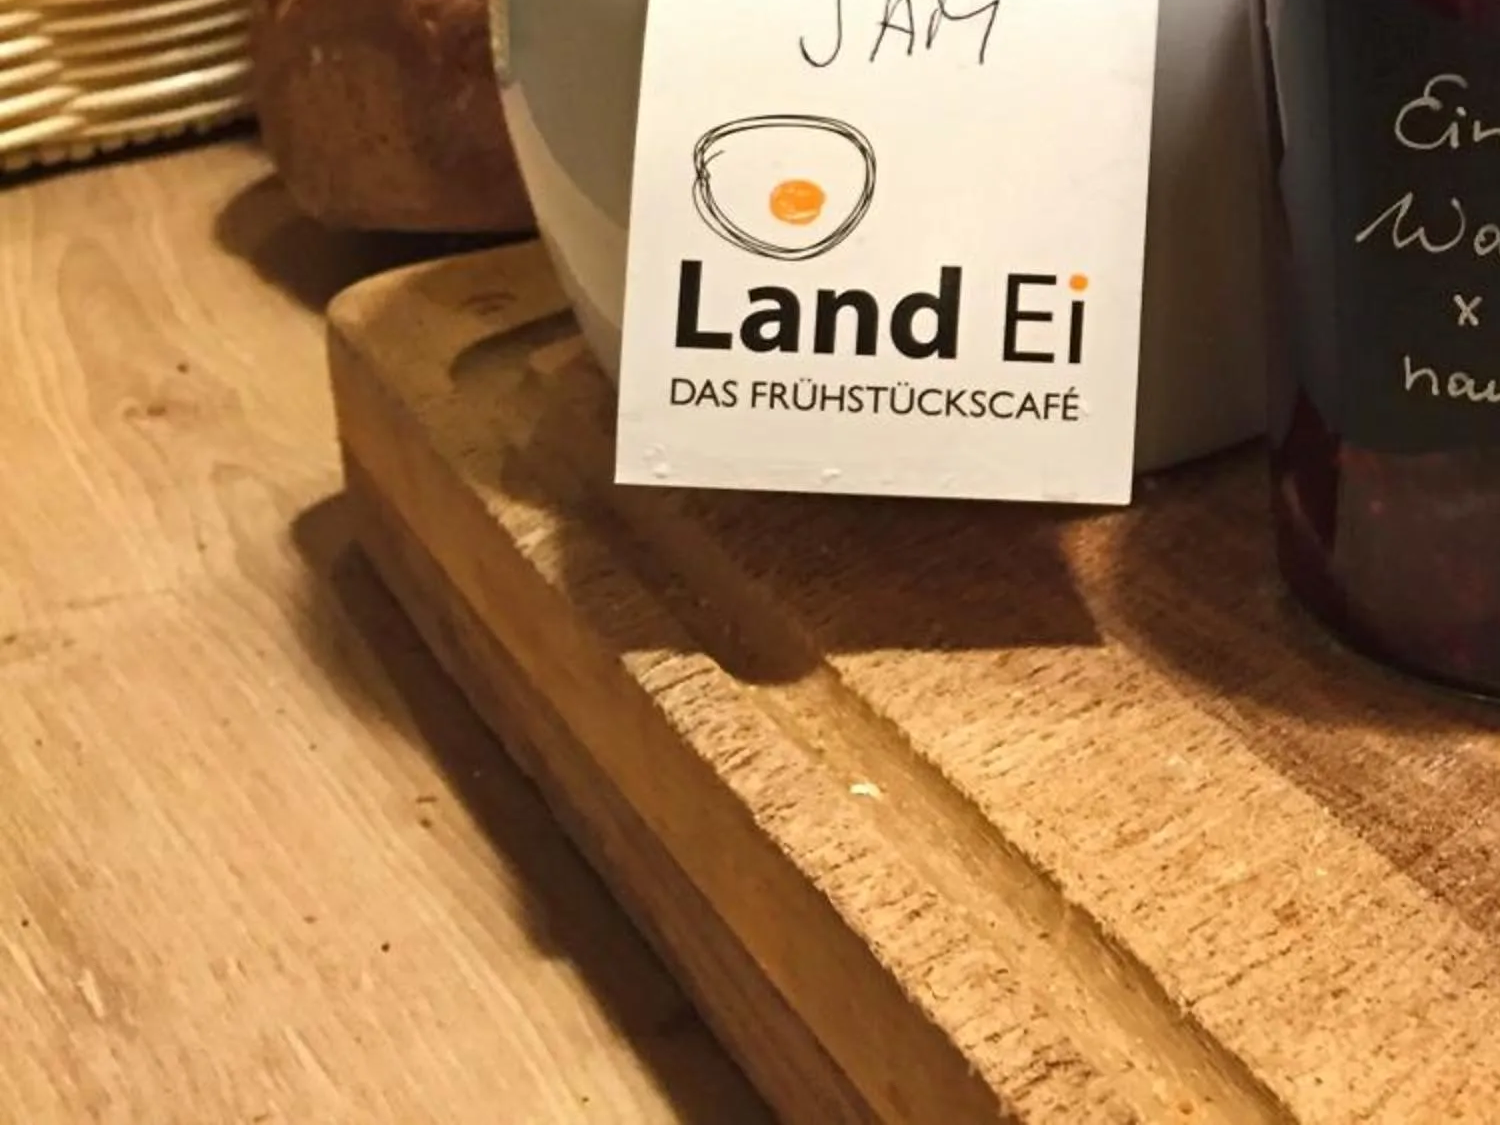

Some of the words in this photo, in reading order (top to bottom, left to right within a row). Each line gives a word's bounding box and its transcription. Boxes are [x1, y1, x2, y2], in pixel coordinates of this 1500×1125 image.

[674, 259, 963, 360] Land
[1002, 272, 1089, 365] Ei
[669, 377, 738, 408] DAS
[749, 378, 1080, 422] FRÜHSTÜCKSCAFÉ
